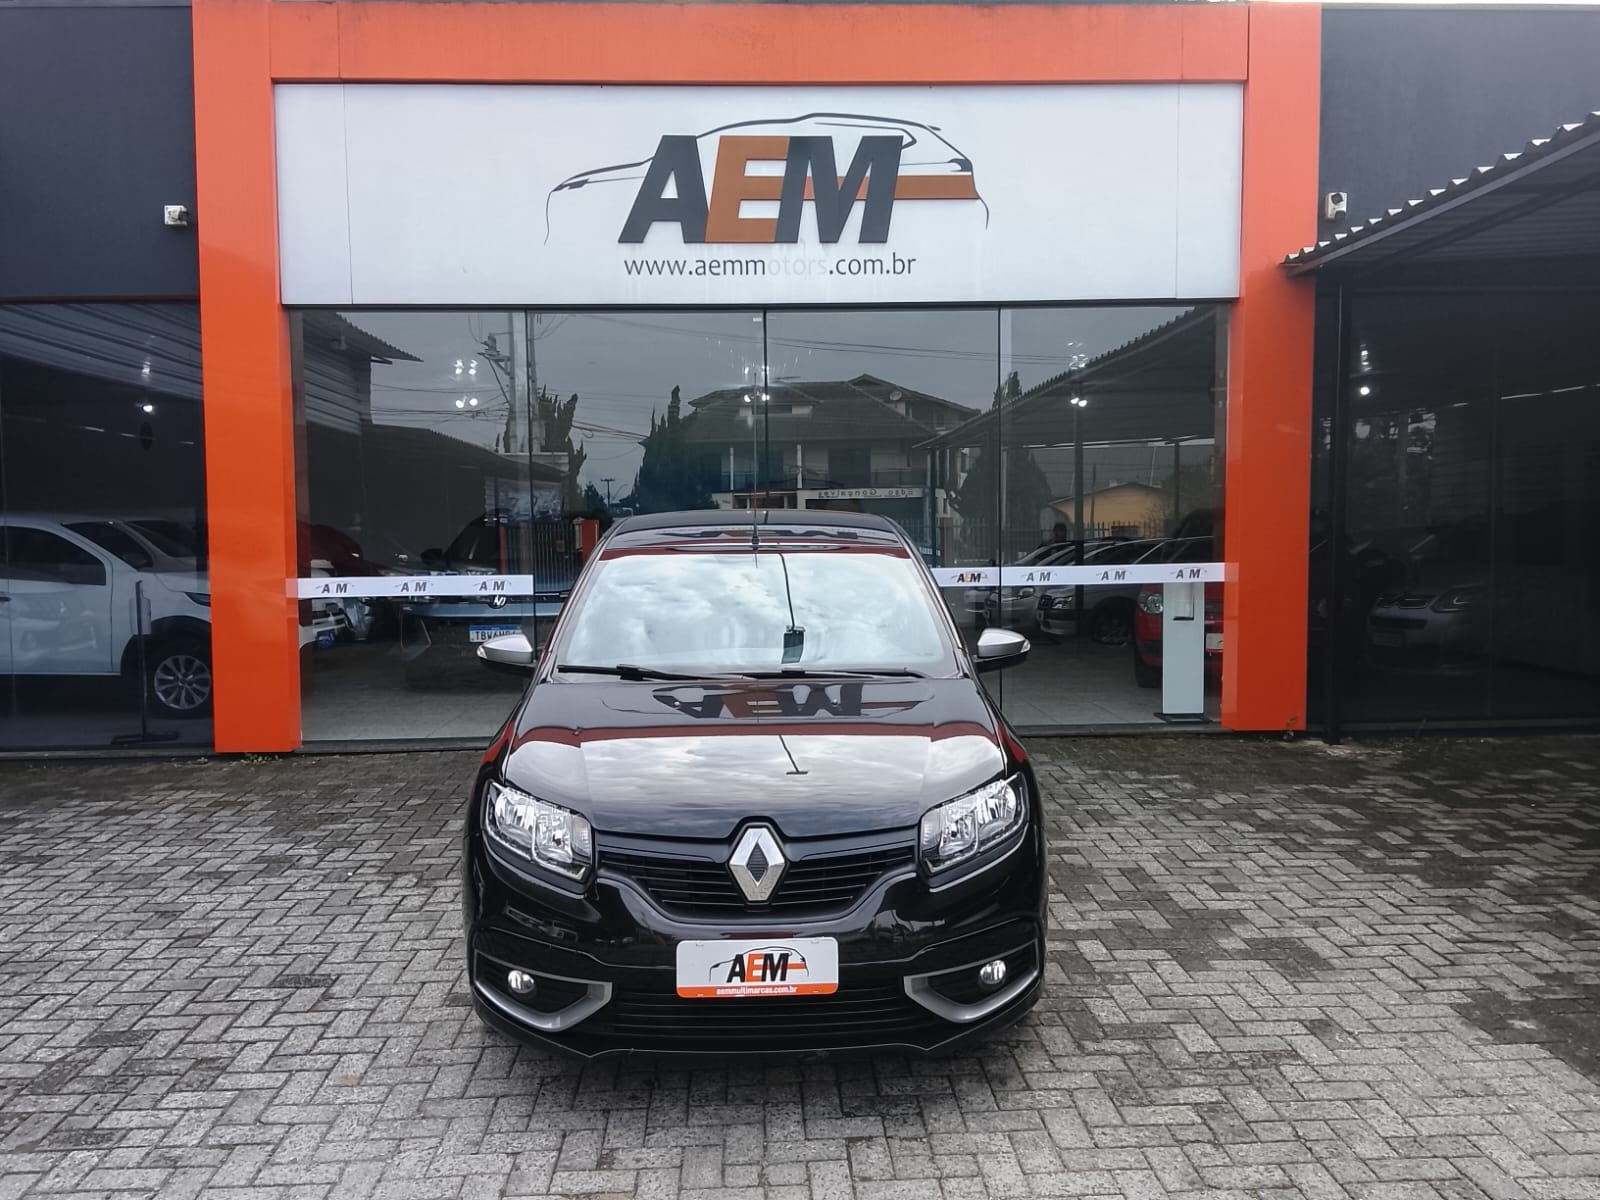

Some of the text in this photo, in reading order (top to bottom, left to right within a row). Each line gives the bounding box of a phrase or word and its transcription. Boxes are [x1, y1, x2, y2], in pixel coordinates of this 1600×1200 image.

[617, 134, 904, 244] AEM
[623, 251, 917, 277] www.aemmotors.com.br
[726, 953, 790, 983] AEM
[716, 985, 798, 995] aemmultimarcas.com.br
